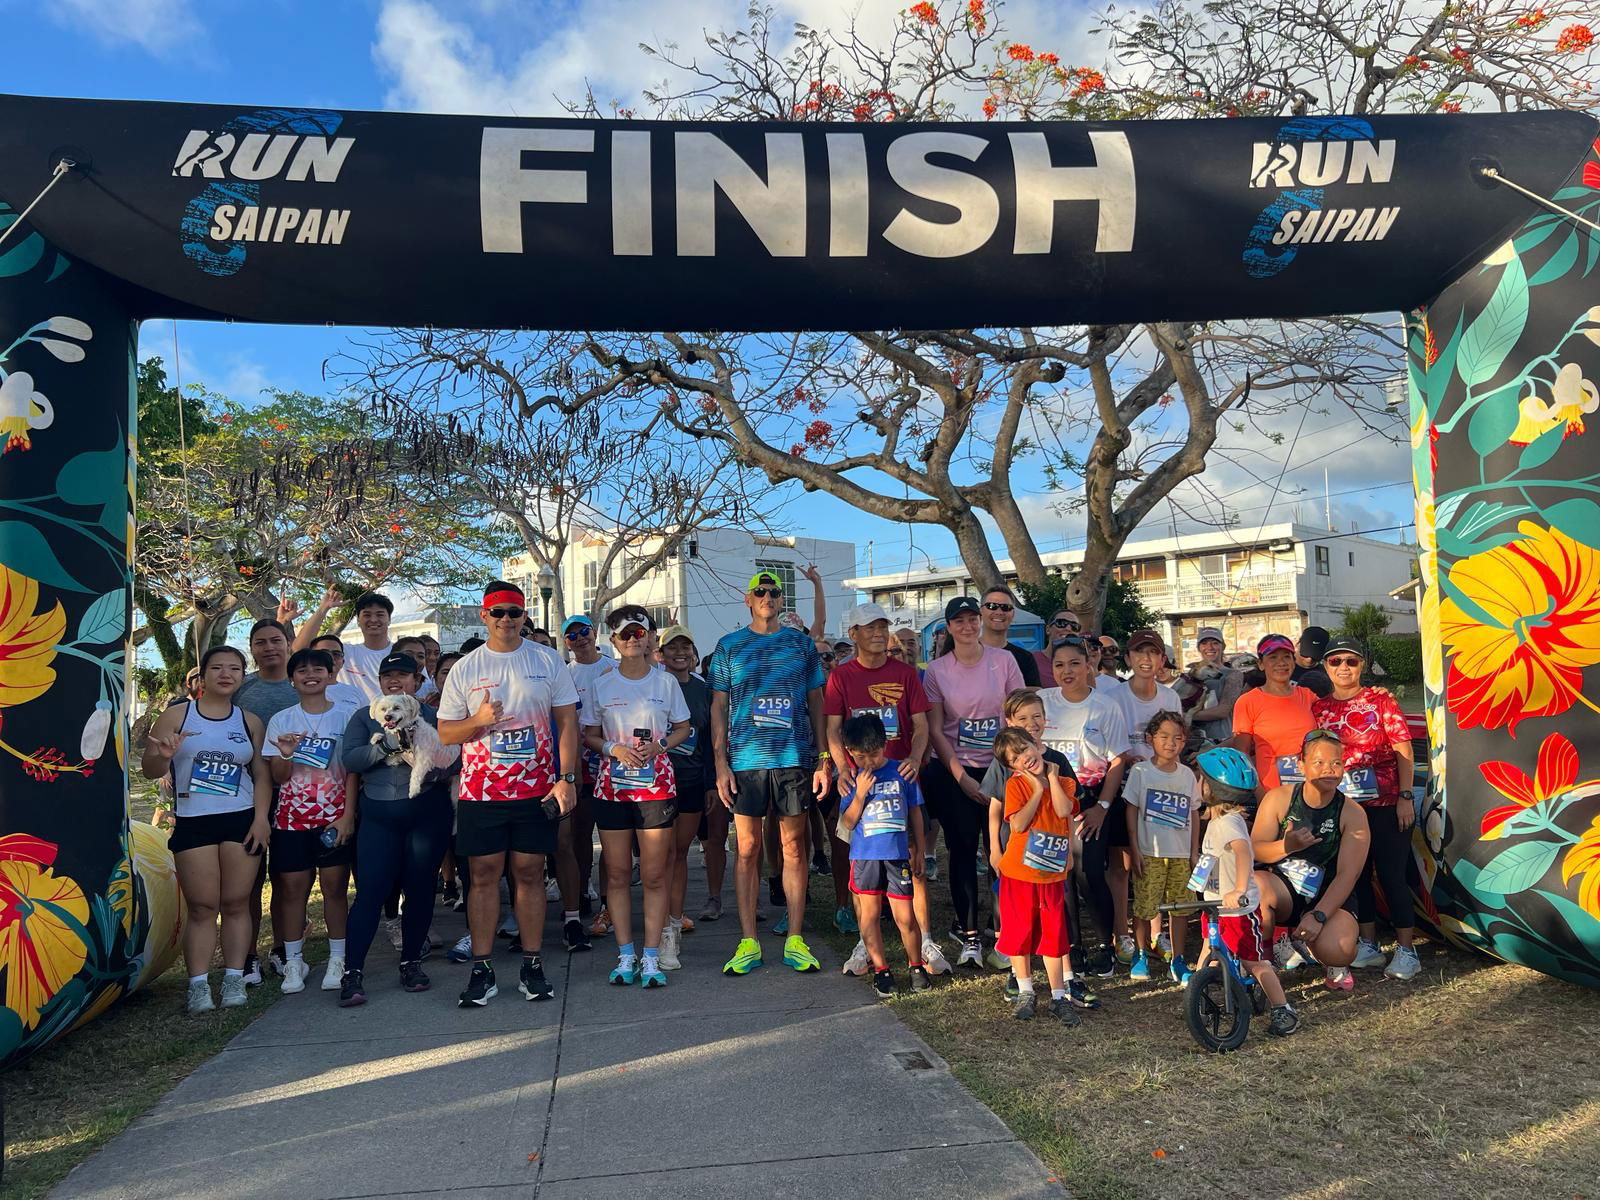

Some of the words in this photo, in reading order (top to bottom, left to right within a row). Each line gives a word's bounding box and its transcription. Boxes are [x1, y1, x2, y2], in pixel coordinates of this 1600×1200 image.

[172, 130, 355, 183] RUN
[1250, 139, 1396, 188] RUN
[480, 127, 1136, 258] FINISH
[210, 205, 351, 245] SAIPAN
[1272, 207, 1400, 246] SAIPAN
[758, 698, 790, 709] 2159
[964, 720, 997, 731] 2142
[299, 737, 330, 750] 190
[496, 728, 530, 745] 2127
[200, 760, 237, 776] 2197
[1341, 770, 1369, 784] 167
[867, 799, 900, 816] 2215
[1153, 792, 1188, 808] 2218
[1034, 833, 1068, 851] 2158
[1282, 858, 1319, 877] 2229
